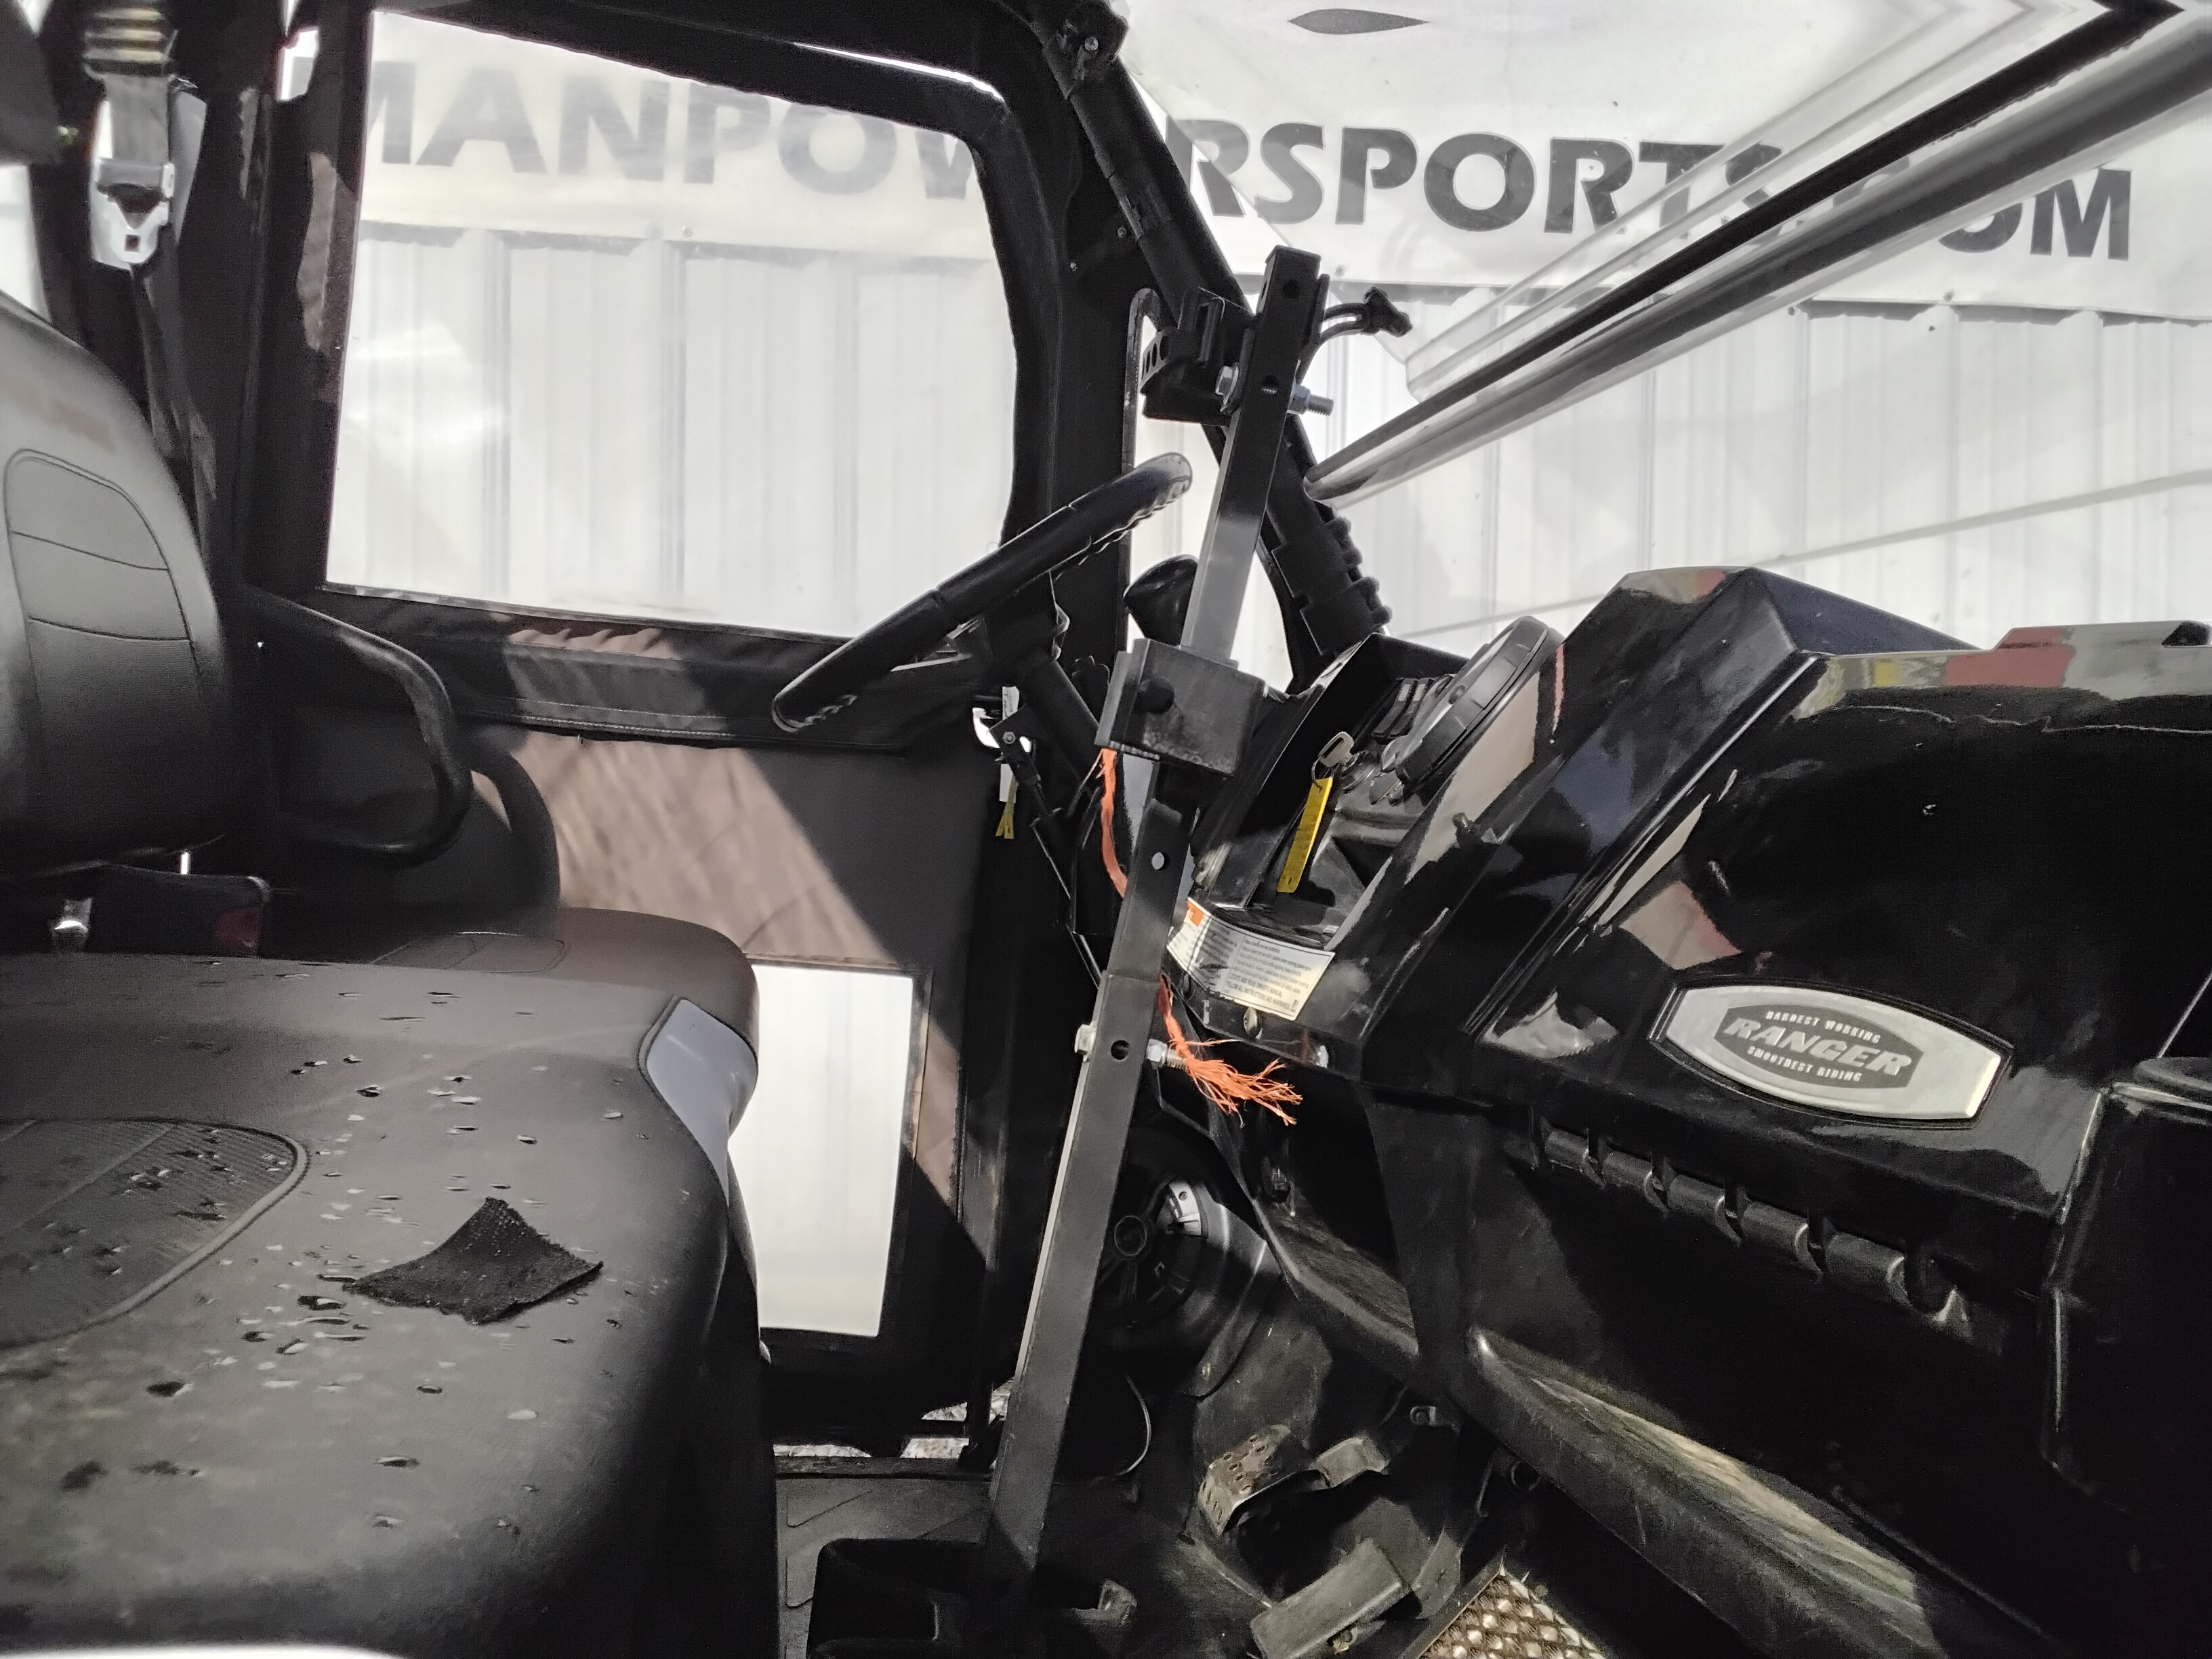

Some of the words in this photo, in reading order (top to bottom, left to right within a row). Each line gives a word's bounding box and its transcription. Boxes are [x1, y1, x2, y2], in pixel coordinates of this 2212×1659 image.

[1765, 1010, 1820, 1026] HARDEST
[1824, 1020, 1881, 1044] WORKING
[1723, 1017, 1912, 1076] RANGER
[1747, 1046, 1813, 1073] SMOOTHEST
[1816, 1065, 1862, 1082] RIDING
